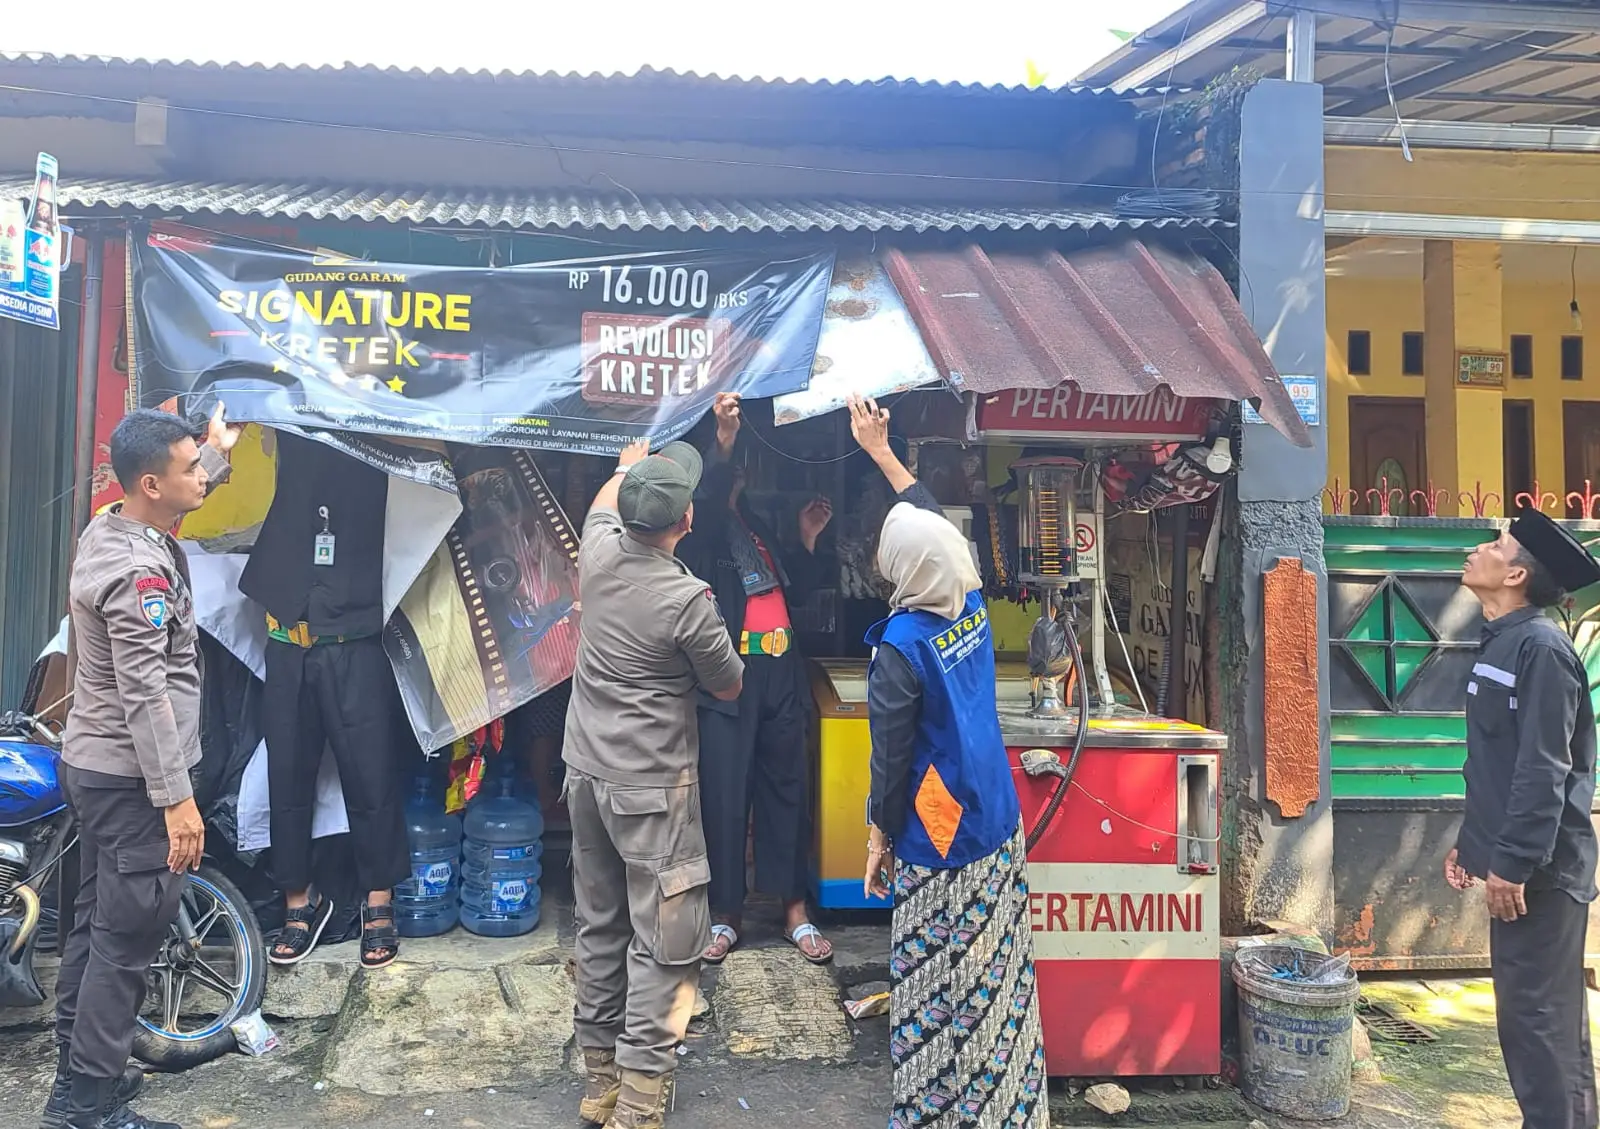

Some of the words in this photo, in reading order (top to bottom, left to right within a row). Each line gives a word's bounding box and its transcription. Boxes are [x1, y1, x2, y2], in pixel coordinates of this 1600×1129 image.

[285, 272, 345, 283] GUDANG
[348, 273, 407, 283] GARAM
[568, 271, 590, 290] RP
[600, 264, 709, 309] 16.000
[713, 291, 748, 309] /BKS
[216, 289, 472, 332] SIGNATURE
[259, 331, 420, 367] KRETEK
[600, 324, 714, 360] REVOLUSI
[601, 359, 713, 396] KRETEK
[1292, 385, 1309, 398] 99
[1010, 385, 1188, 423] PERTAMINI
[505, 438, 532, 447] ORANG
[543, 440, 569, 450] BAWAH
[571, 441, 579, 449] 21
[580, 443, 605, 453] TAHUN
[552, 429, 589, 441] LAYANAN
[591, 432, 630, 443] BERHENTI
[936, 607, 986, 650] SATGAS
[502, 885, 525, 896] AQUA
[1029, 892, 1203, 933] ERTAMINI
